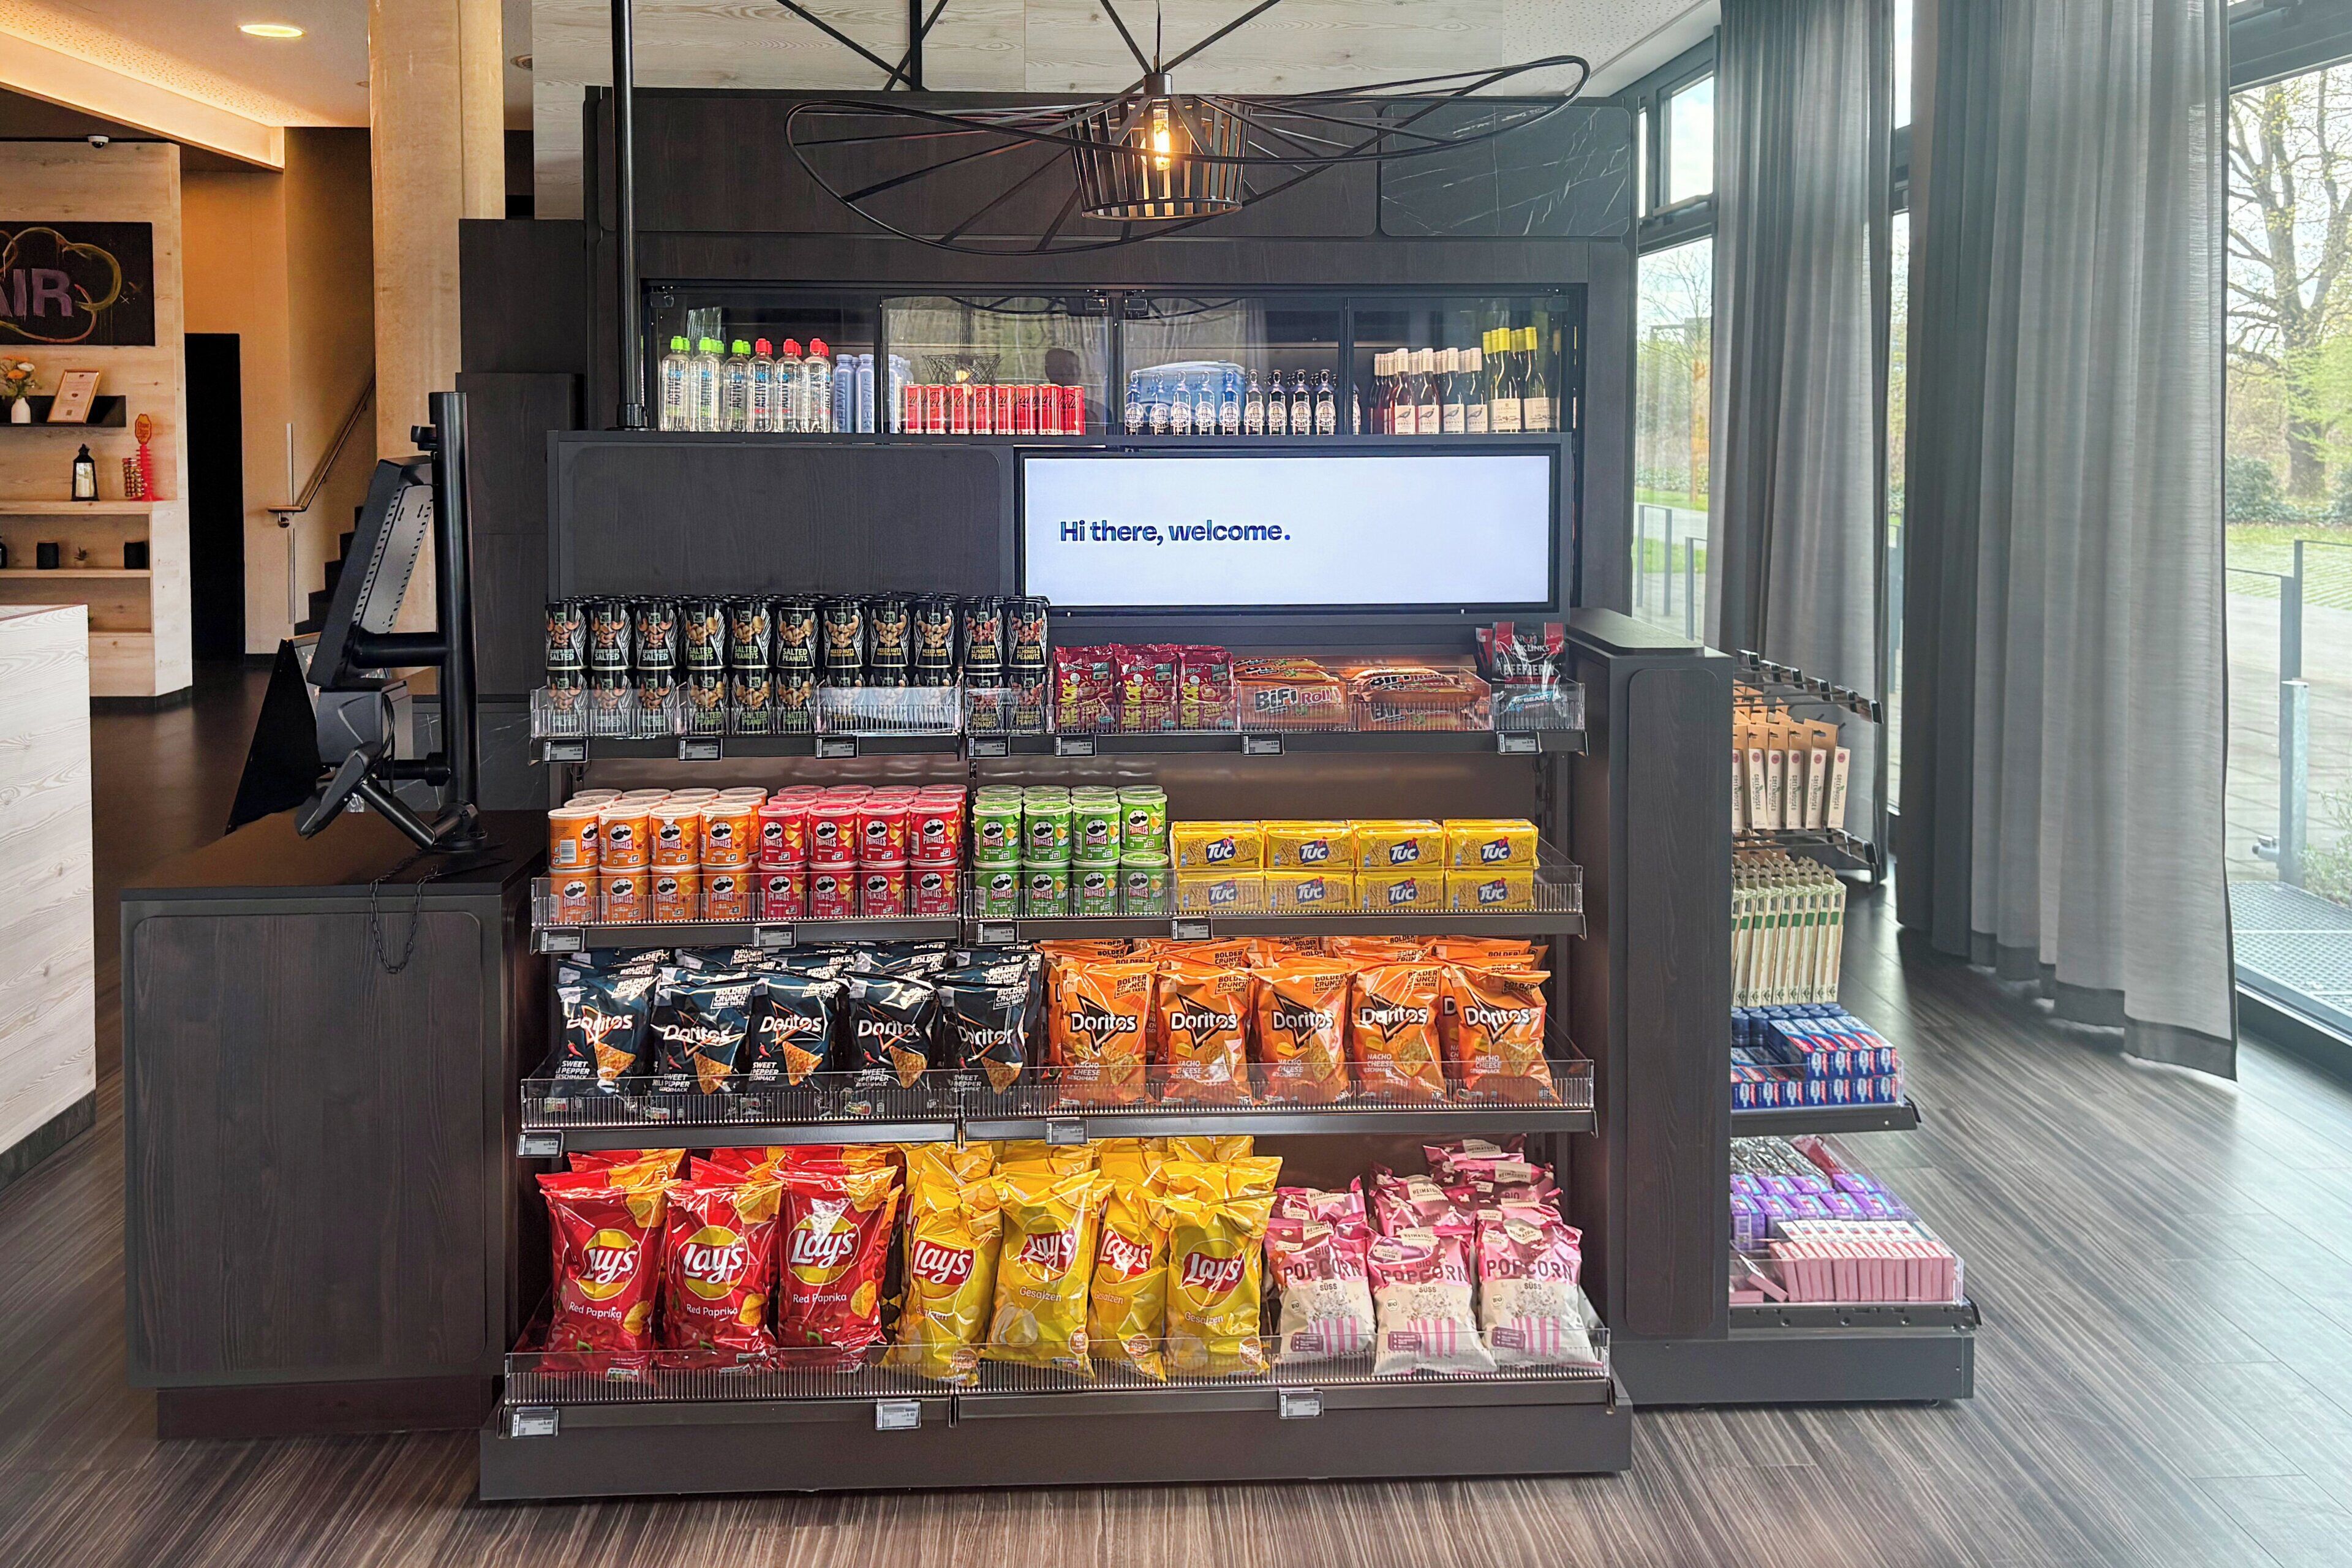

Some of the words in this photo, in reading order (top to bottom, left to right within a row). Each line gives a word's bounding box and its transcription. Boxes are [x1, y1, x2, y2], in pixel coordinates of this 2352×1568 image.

[755, 379, 766, 407] ACTIVE
[1060, 520, 1085, 541] Hi
[1090, 520, 1164, 545] there,
[1168, 519, 1291, 541] welcome.
[1254, 688, 1298, 712] BiFi
[1300, 688, 1332, 705] Roll
[1128, 825, 1148, 835] PRINGLES
[610, 840, 633, 850] PRINGLES
[659, 839, 681, 850] PRINGLES
[710, 838, 732, 850] PRINGLES
[764, 838, 783, 848] PRINGLES
[816, 837, 837, 847] PRINGLES
[866, 836, 887, 846] PRINGLES
[923, 834, 944, 845] PRINGLES
[982, 837, 1004, 846] PRINGLES
[1033, 837, 1054, 846] PRINGLES
[1086, 835, 1107, 845] PRINGLES
[989, 972, 1020, 981] CRUNCH
[1117, 974, 1147, 986] BOLDER
[714, 993, 746, 1002] CRUNCH
[715, 987, 749, 996] BOLDER
[997, 987, 1028, 996] BOLDER
[759, 1014, 822, 1033] Doritos
[1071, 1012, 1137, 1031] Doritos
[1171, 1012, 1237, 1030] Doritos
[1272, 1011, 1334, 1030] Doritos
[1361, 1008, 1428, 1025] Doritos
[1465, 1008, 1531, 1027] Doritos
[791, 1229, 856, 1269] Lay's
[1019, 1230, 1075, 1267] Lay's
[1099, 1229, 1151, 1272] Lay's
[1315, 1245, 1330, 1256] BIO
[684, 1243, 745, 1284] Lay's
[913, 1240, 971, 1285] Lay's
[1415, 1259, 1431, 1268] BIO
[1180, 1252, 1245, 1292] Lay's
[1284, 1258, 1363, 1284] POPCORN
[1379, 1264, 1468, 1284] POPCORN
[1487, 1259, 1573, 1282] POPCORN
[1319, 1283, 1338, 1291] SÜSS
[1524, 1282, 1542, 1291] SÜSS
[793, 1294, 810, 1303] Red
[812, 1293, 847, 1305] Paprika
[1019, 1286, 1063, 1303] Gesalzen
[569, 1302, 584, 1314] Red
[586, 1306, 622, 1320] Paprika
[687, 1303, 701, 1315] Red
[703, 1306, 738, 1317] Paprika
[1185, 1311, 1224, 1325] Gesalzen
